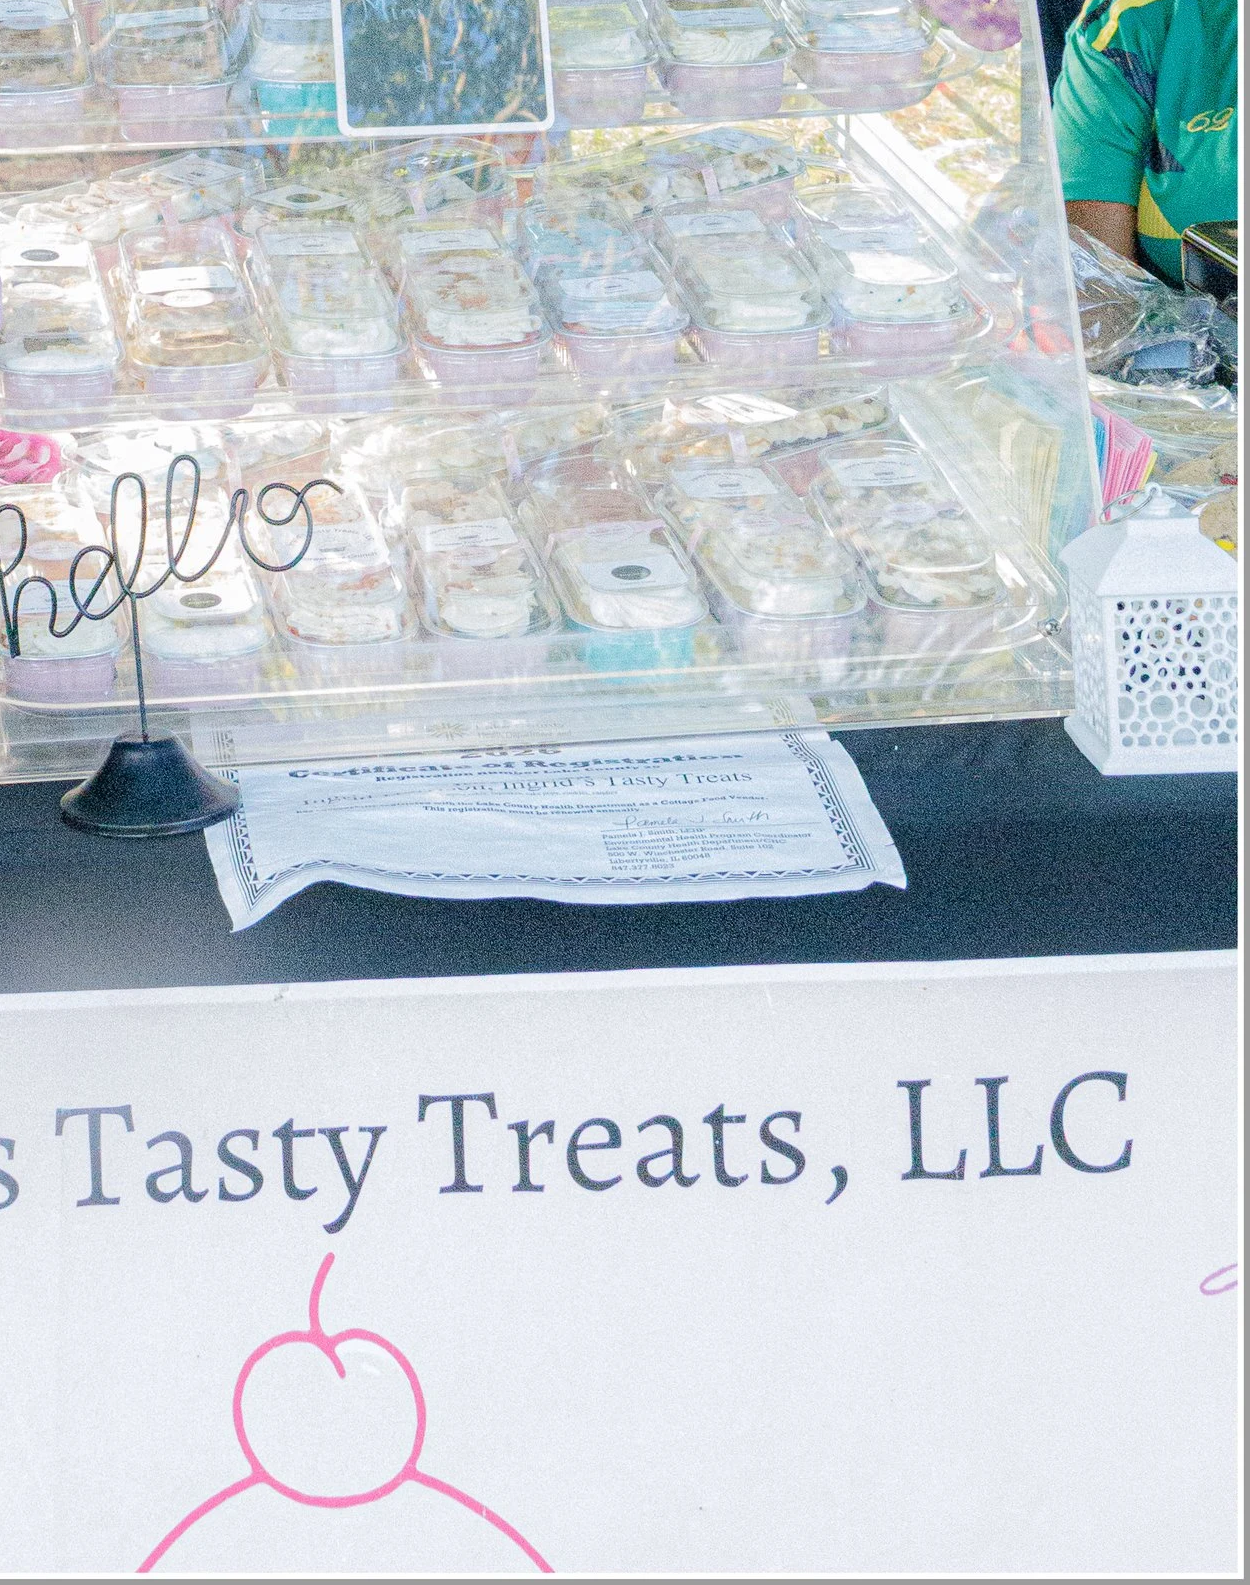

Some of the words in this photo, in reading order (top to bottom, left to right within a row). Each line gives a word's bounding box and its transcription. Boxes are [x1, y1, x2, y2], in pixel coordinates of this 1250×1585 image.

[288, 764, 472, 780] Certificate
[481, 760, 516, 769] of
[523, 753, 744, 769] Registration
[375, 771, 474, 783] Registration
[603, 774, 669, 789] Tasty
[675, 771, 753, 785] Treats
[447, 805, 507, 814] registration
[503, 801, 539, 810] County
[576, 801, 637, 811] Department
[660, 798, 700, 807] Cottage
[702, 795, 726, 803] Food
[601, 831, 637, 841] Pamela
[603, 837, 674, 846] Environmental
[676, 833, 708, 842] Health
[709, 831, 752, 840] Program
[753, 831, 812, 839] Coordinator
[630, 843, 666, 852] County
[667, 840, 700, 849] Health
[643, 846, 699, 857] Winchester
[730, 842, 755, 851] Suite
[757, 842, 775, 850] 102
[56, 1107, 387, 1234] Tasty
[418, 1093, 849, 1204] Treats,
[897, 1070, 1133, 1181] LLC
